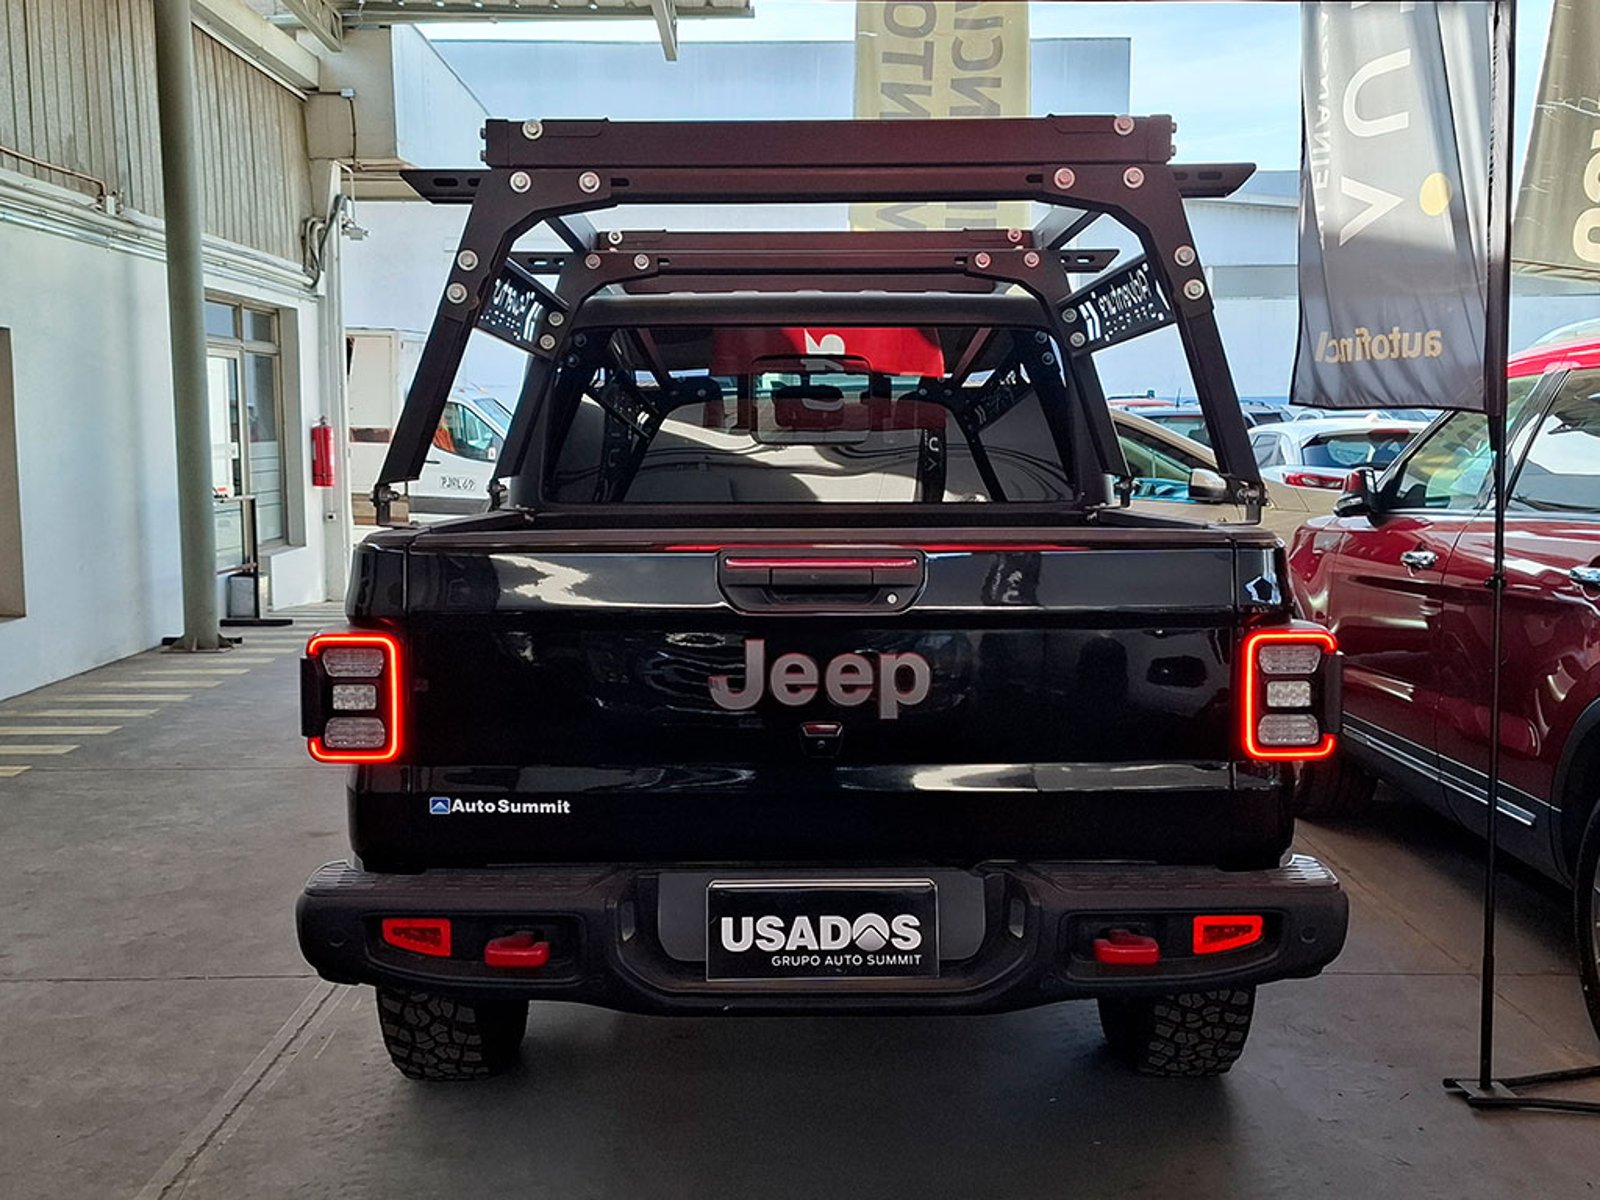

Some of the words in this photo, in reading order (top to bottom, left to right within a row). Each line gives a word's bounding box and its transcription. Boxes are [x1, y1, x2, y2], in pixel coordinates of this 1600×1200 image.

[708, 638, 931, 720] Jeep
[720, 911, 923, 953] USADOS
[771, 954, 820, 967] GRUPO
[824, 954, 864, 966] AUTO
[866, 953, 923, 966] SUMMIT
